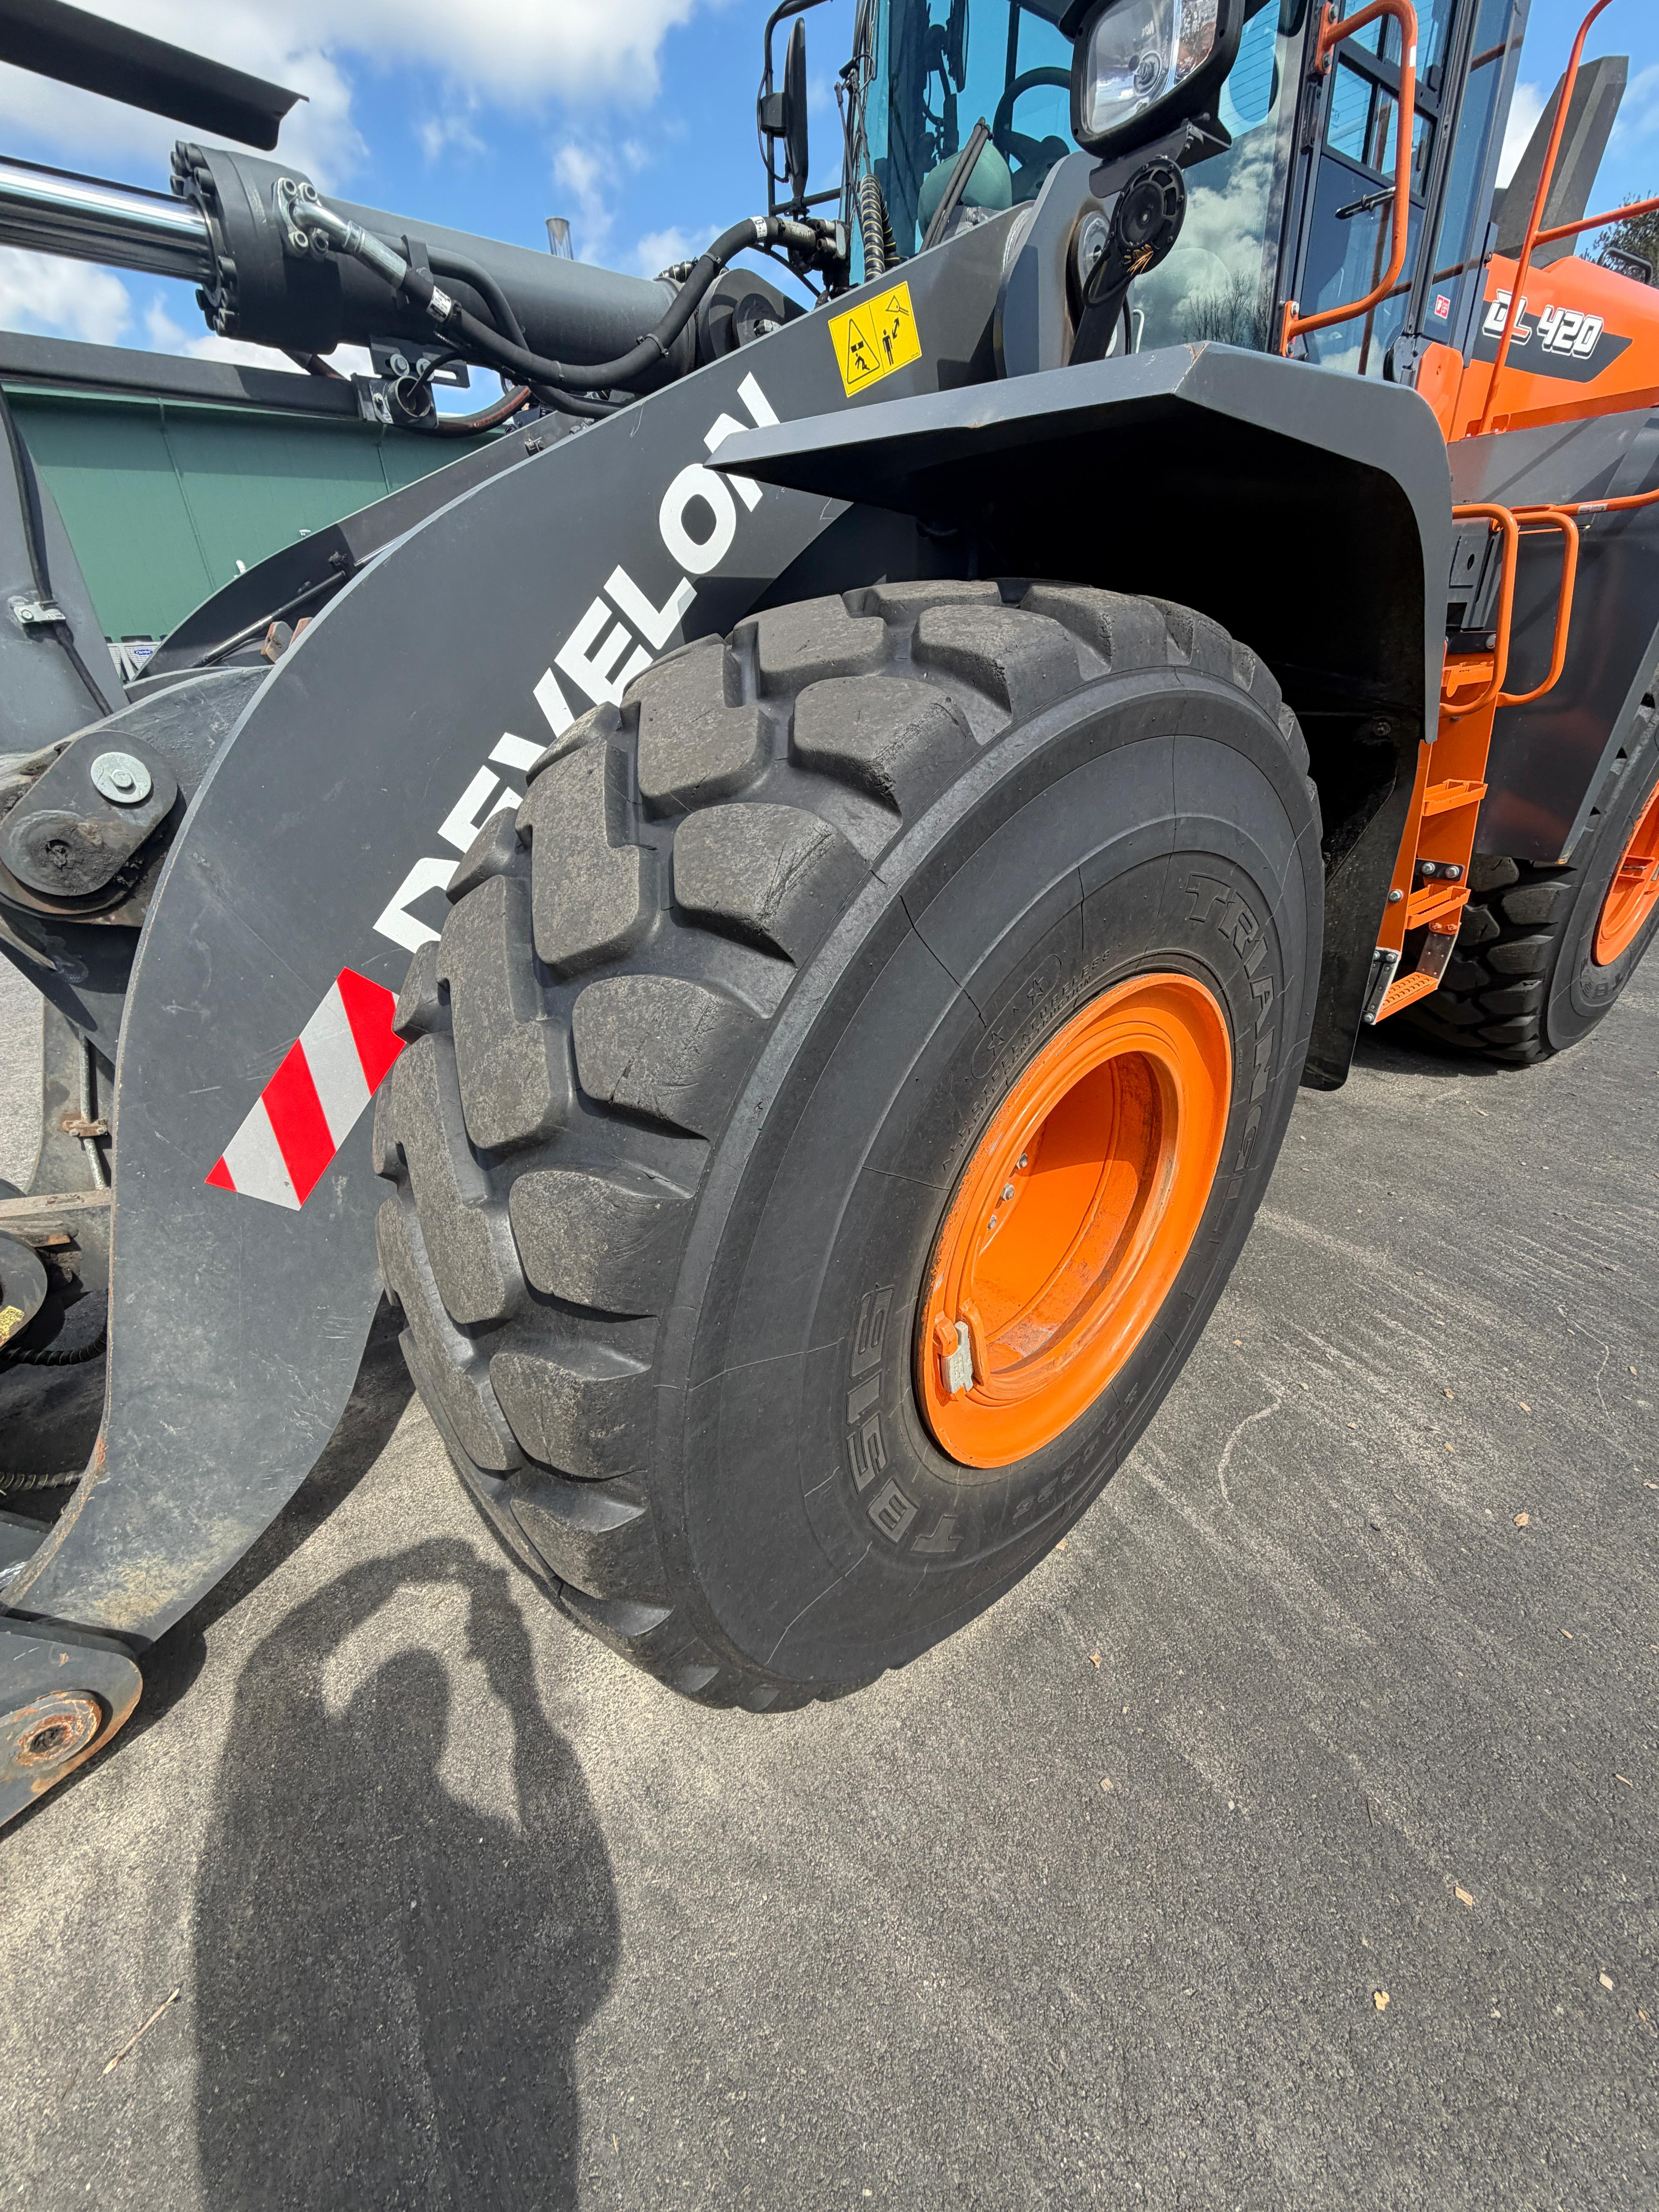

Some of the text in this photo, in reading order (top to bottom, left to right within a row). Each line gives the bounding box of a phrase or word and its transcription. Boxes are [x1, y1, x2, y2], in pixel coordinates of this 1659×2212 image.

[1482, 288, 1532, 346] DL
[1536, 304, 1605, 360] 420
[972, 1045, 1019, 1115] STEEL
[1030, 949, 1111, 1030] TUBELESS
[845, 1284, 964, 1553] TB516
